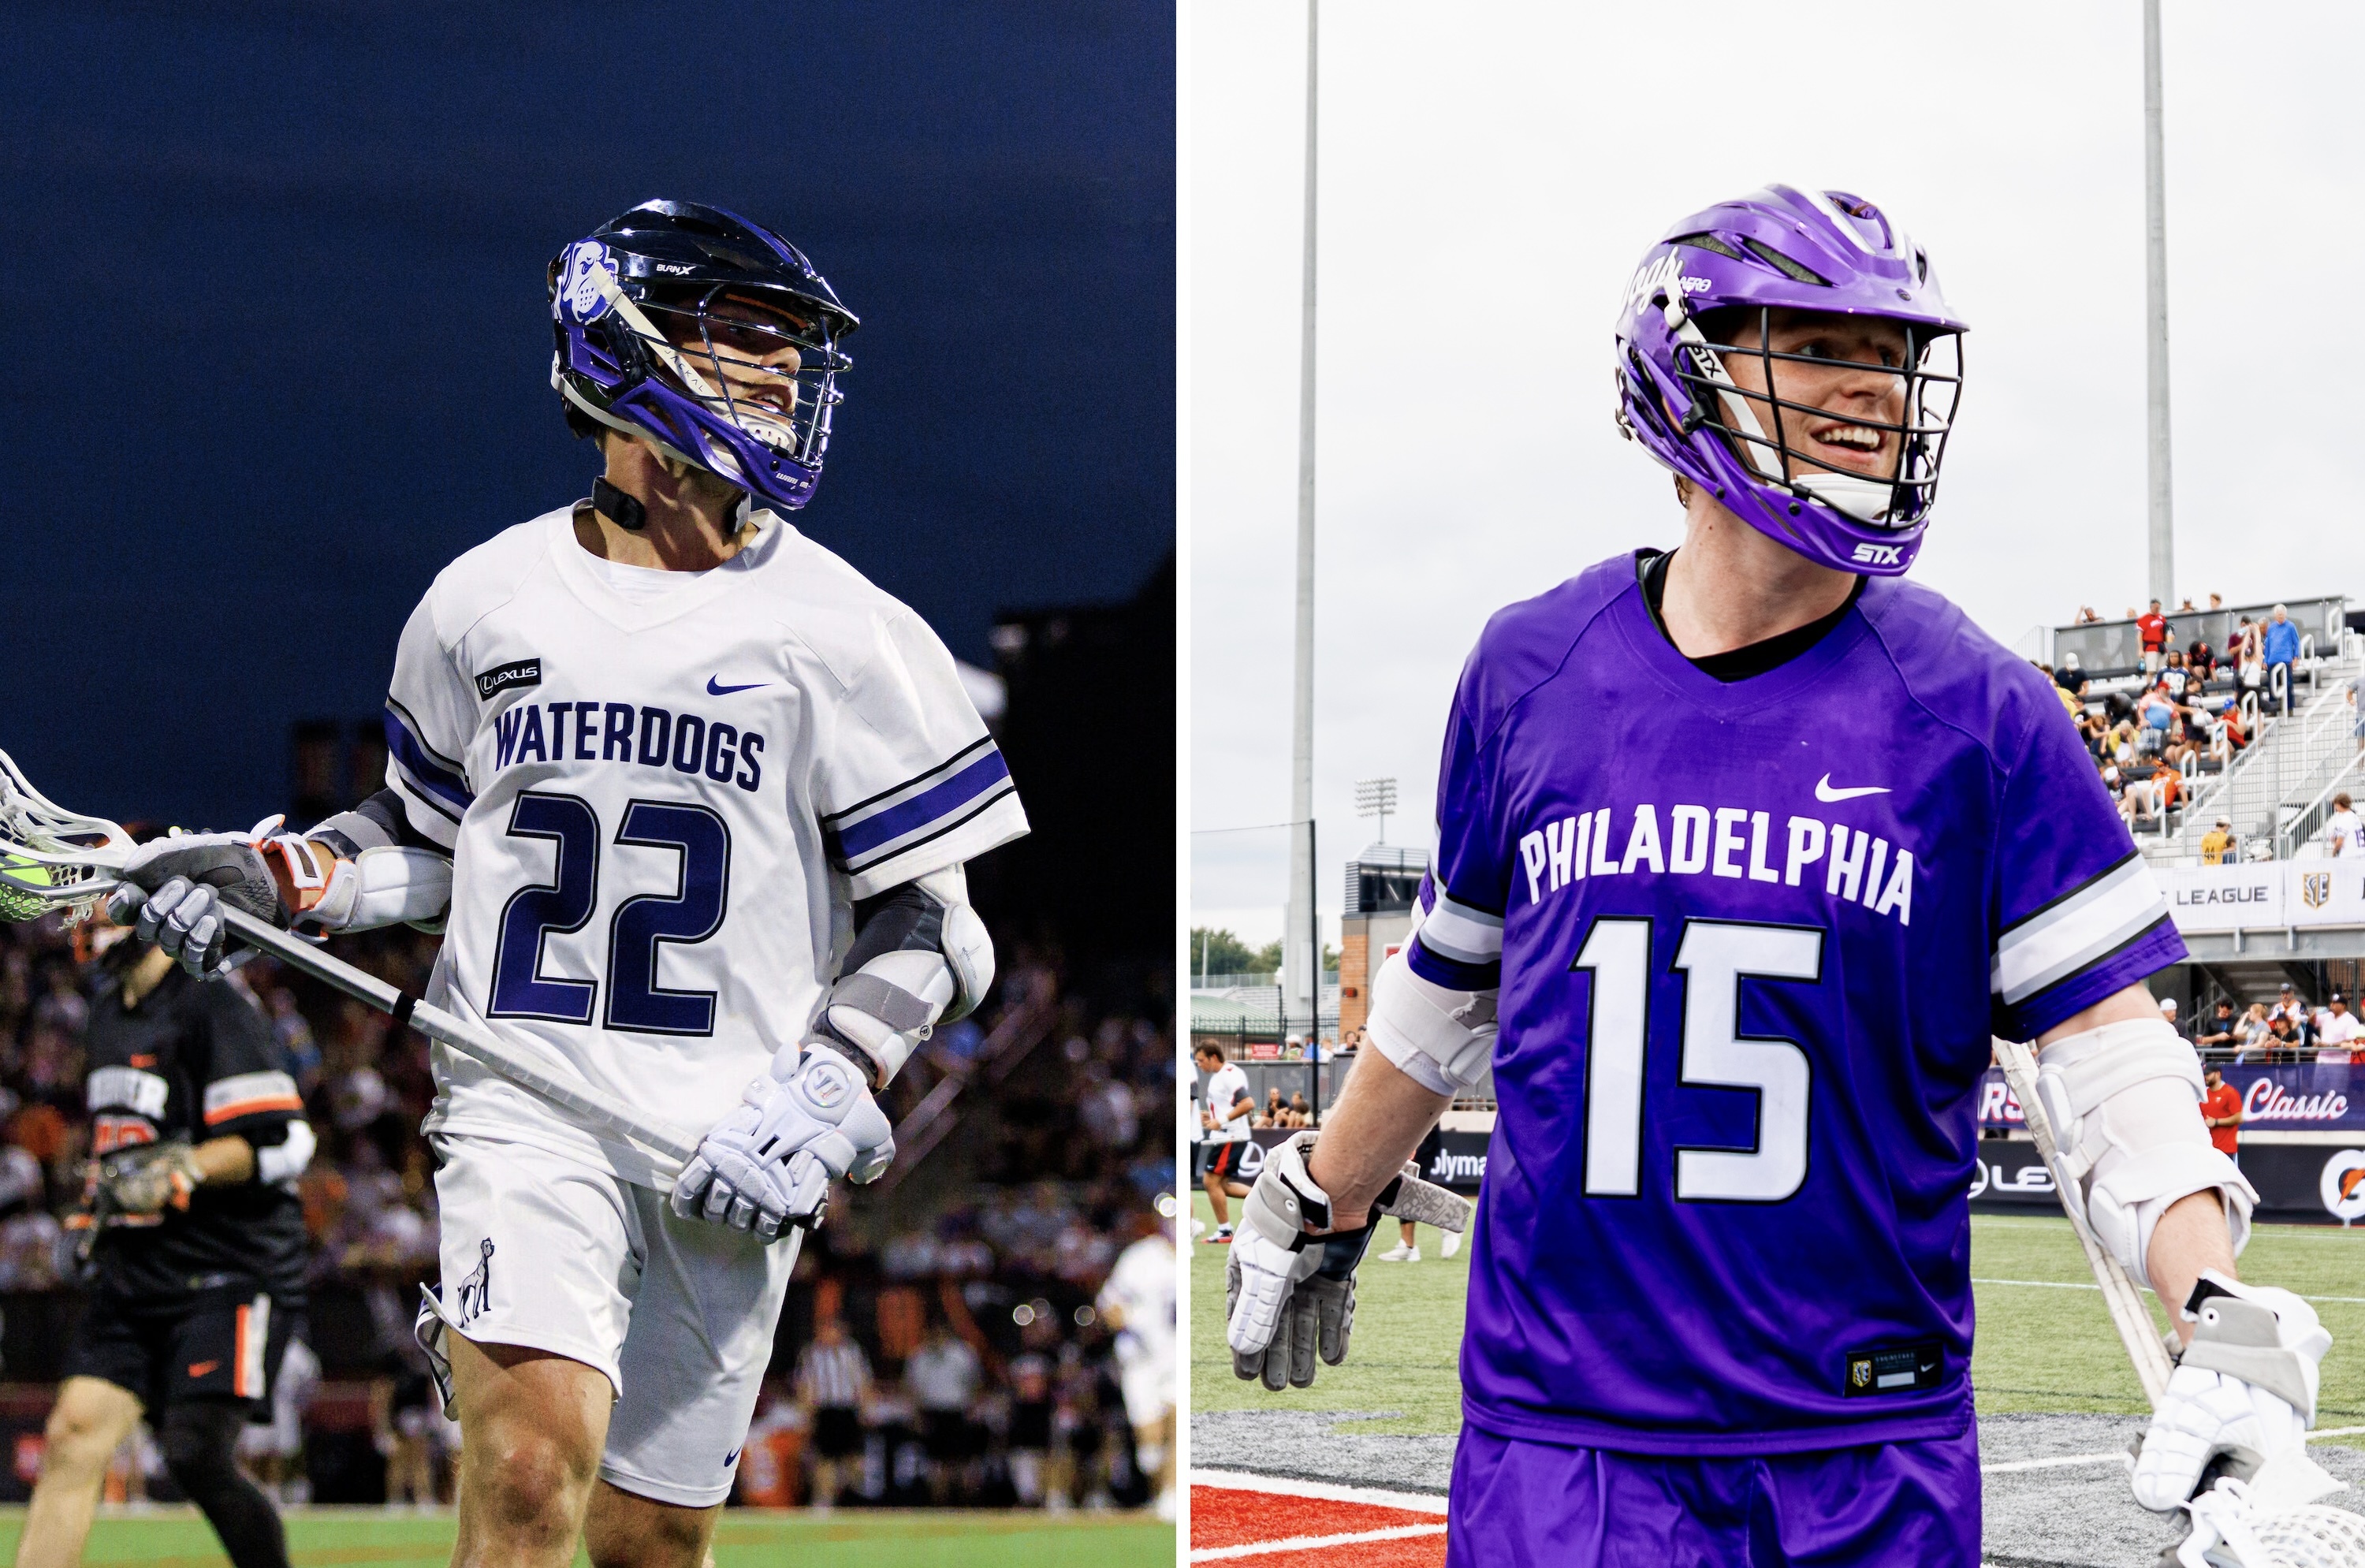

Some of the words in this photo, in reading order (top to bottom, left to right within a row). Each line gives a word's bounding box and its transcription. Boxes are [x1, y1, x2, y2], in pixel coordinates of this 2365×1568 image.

[1850, 542, 1905, 565] STX
[493, 666, 538, 686] LEXUS
[494, 702, 765, 792] WATERDOGS
[1519, 803, 1914, 927] PHILADELPHIA
[2177, 885, 2269, 906] LEAGUE
[486, 789, 732, 1037] 22
[1567, 914, 1827, 1204] 15
[2243, 1077, 2349, 1122] Classic
